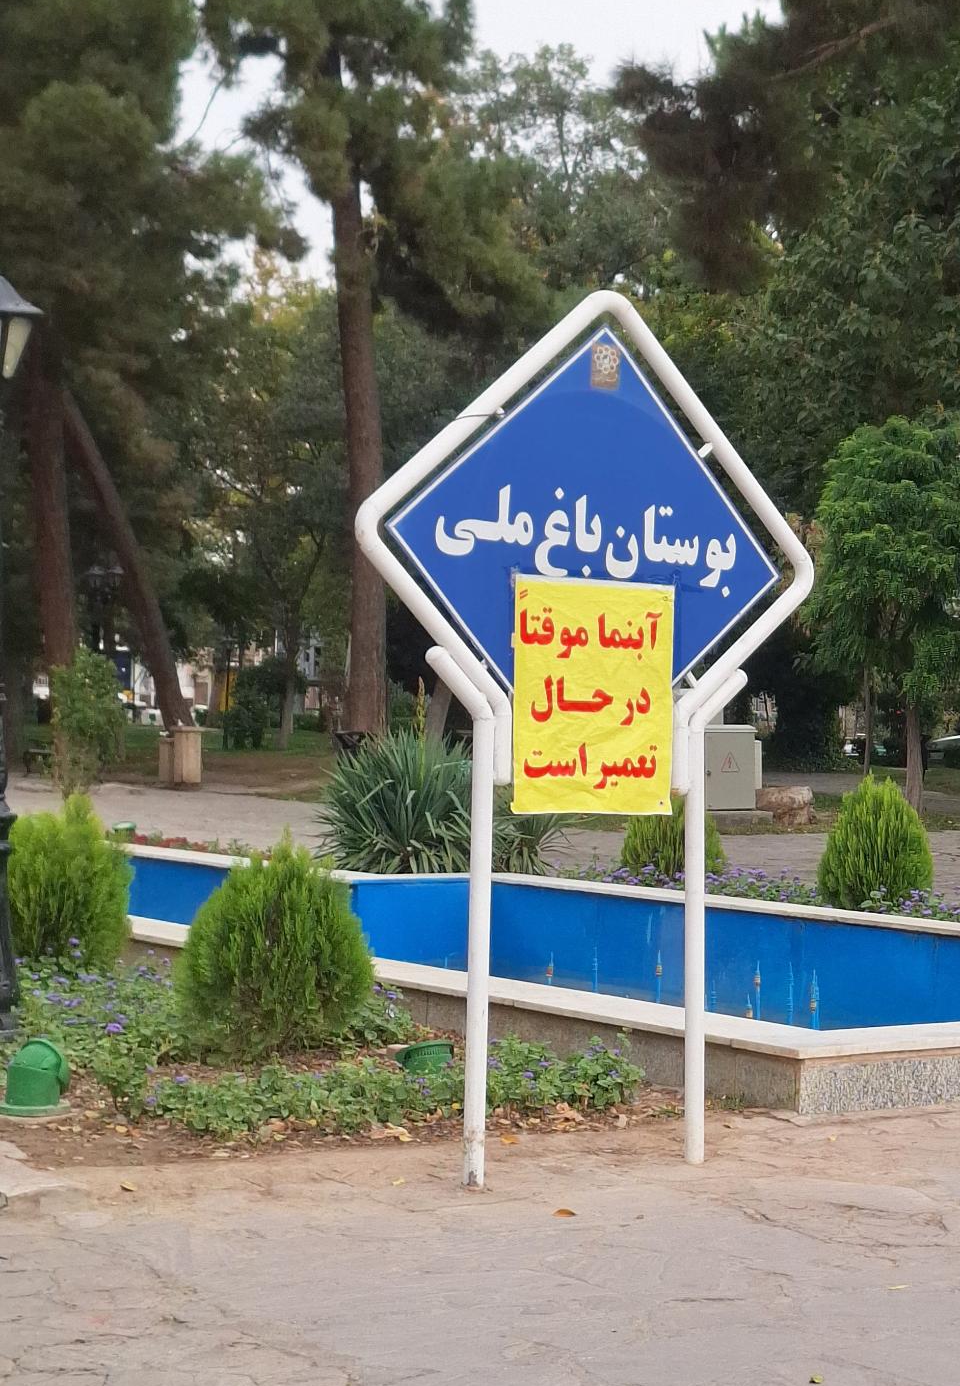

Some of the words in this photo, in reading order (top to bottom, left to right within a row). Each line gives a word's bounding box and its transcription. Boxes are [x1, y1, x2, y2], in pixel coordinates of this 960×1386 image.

[435, 484, 534, 557] ملی
[534, 487, 602, 578] باغ
[605, 504, 737, 598] بوستان
[597, 611, 663, 661] آبنما
[530, 674, 614, 722] حال
[620, 686, 651, 726] در
[523, 742, 588, 779] است
[593, 745, 658, 789] تعمیر
